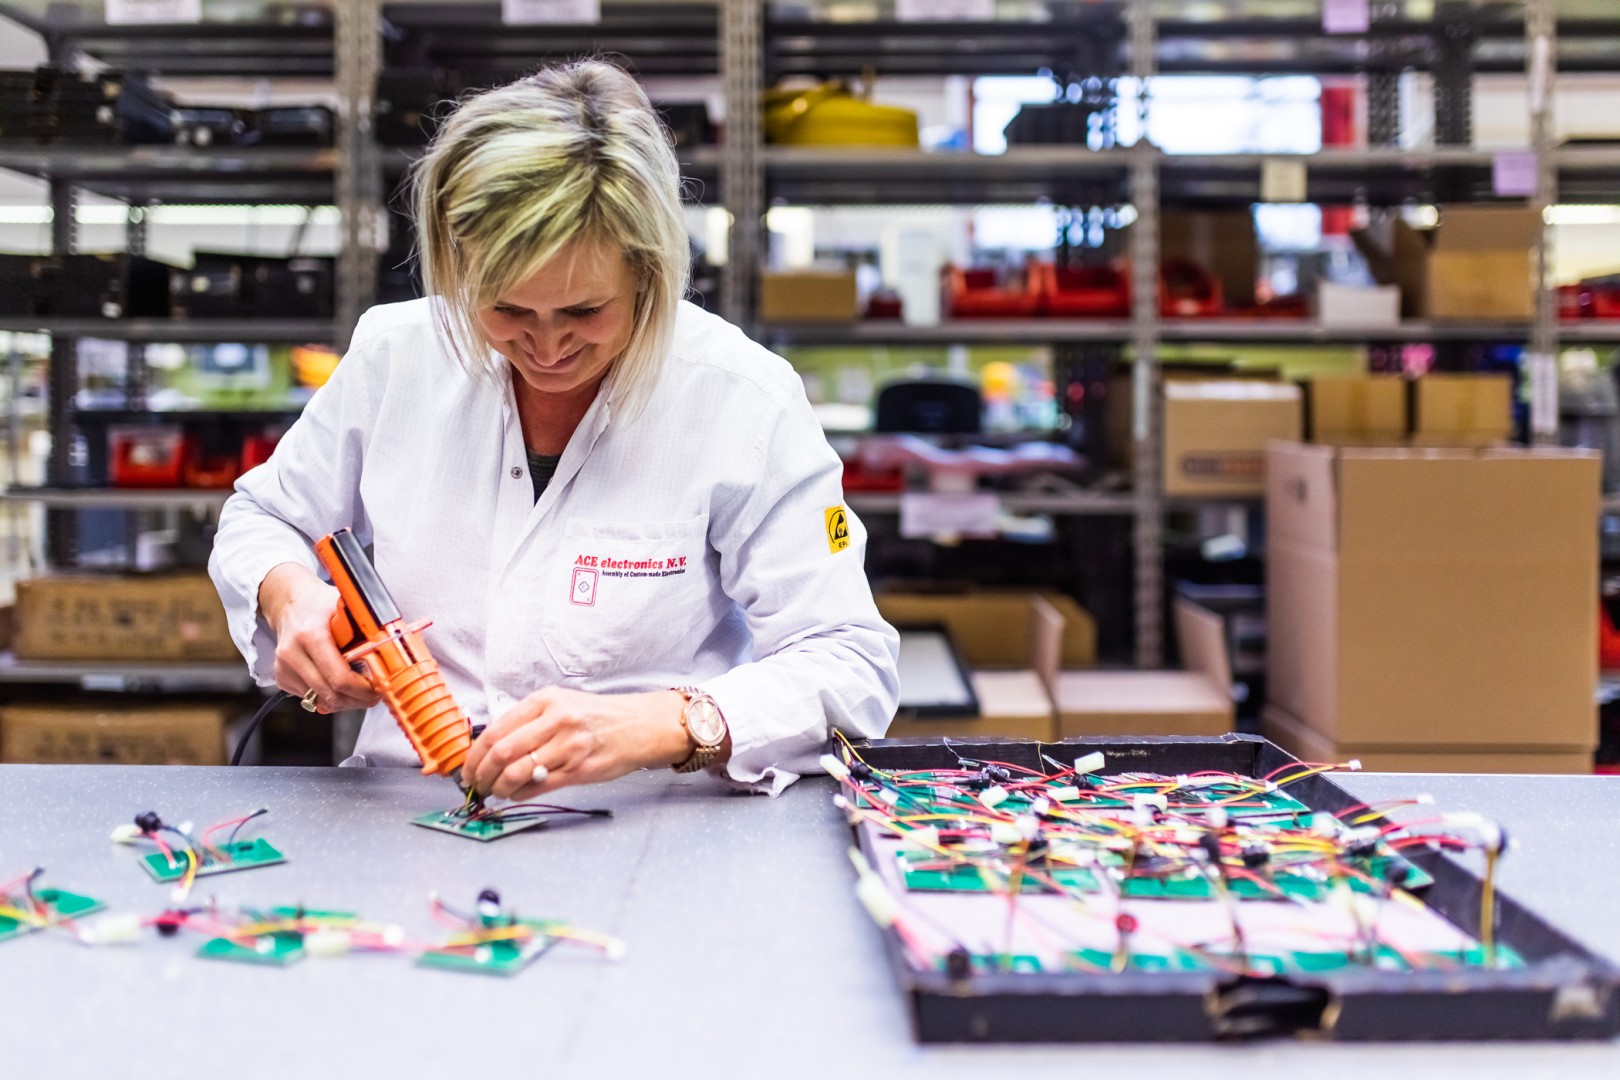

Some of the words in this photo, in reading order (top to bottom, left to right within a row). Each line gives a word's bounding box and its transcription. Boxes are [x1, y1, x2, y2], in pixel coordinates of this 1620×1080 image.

[575, 555, 598, 567] ACE
[601, 558, 663, 569] electronics
[666, 556, 687, 569] N.V.
[602, 570, 623, 578] Assembly
